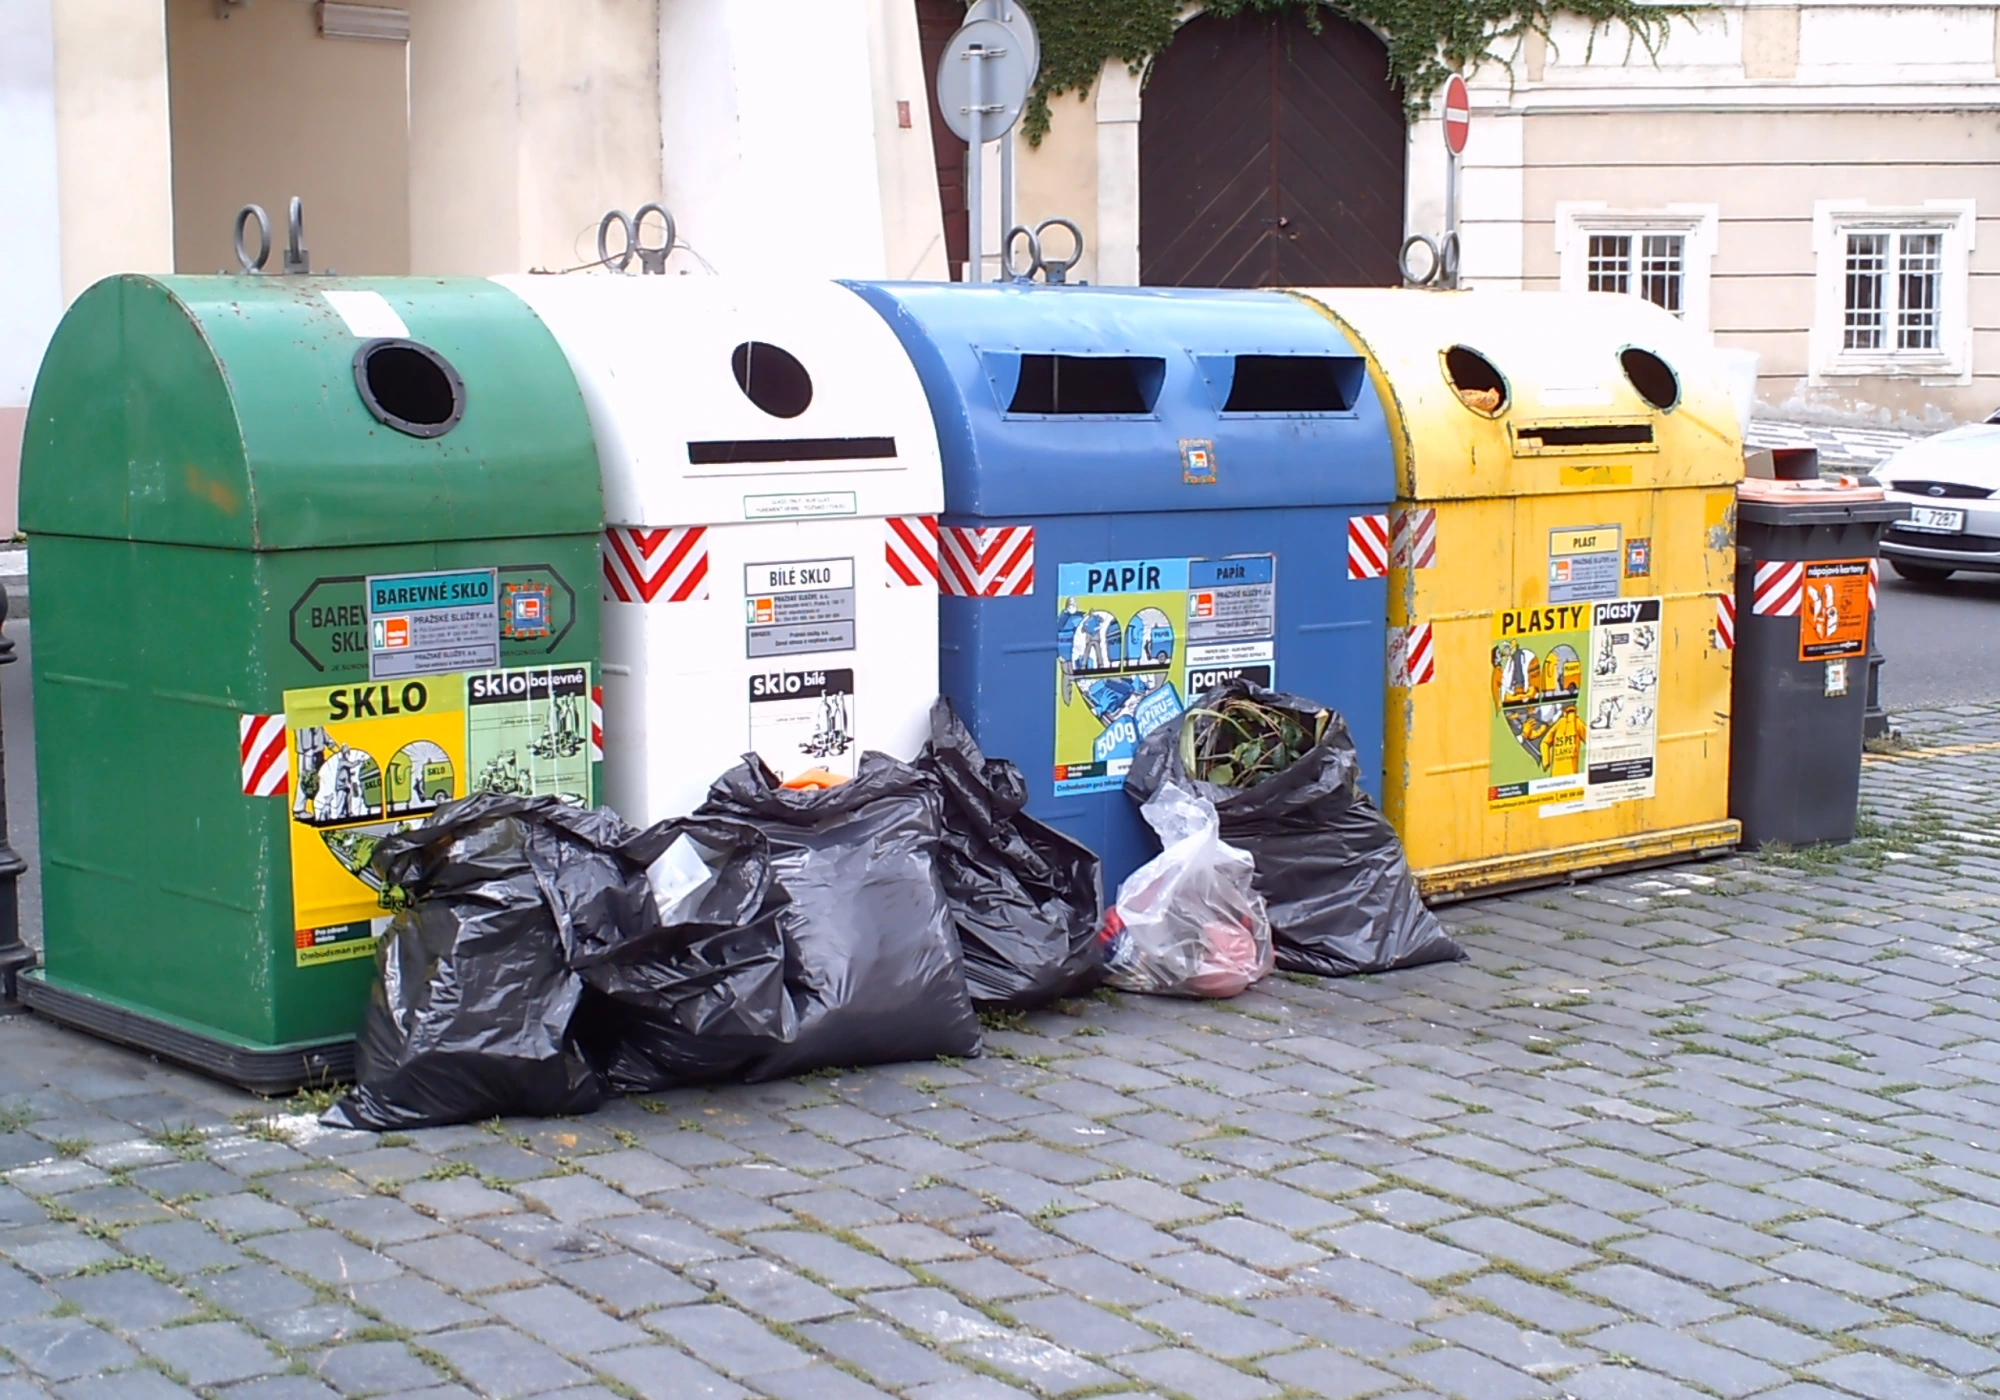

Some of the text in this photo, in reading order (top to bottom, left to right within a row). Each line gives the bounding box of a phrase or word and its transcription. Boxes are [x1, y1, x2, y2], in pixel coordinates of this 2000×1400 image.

[1573, 536, 1596, 548] PLAST
[769, 567, 831, 587] BÍLÉ SKLO
[1088, 562, 1160, 592] PAPÍR
[1217, 564, 1245, 580] PAPÍR
[376, 581, 489, 605] BAREVNÉ SKLO
[1502, 606, 1583, 635] PLASTY
[1597, 602, 1642, 626] plasty
[473, 669, 584, 698] sklo barevné
[753, 671, 826, 696] sklo bílé
[329, 682, 427, 721] SKLO
[1097, 721, 1136, 759] 500g
[427, 767, 446, 776] SKLO
[300, 947, 351, 961] Ombudsman
[353, 944, 366, 954] pro
